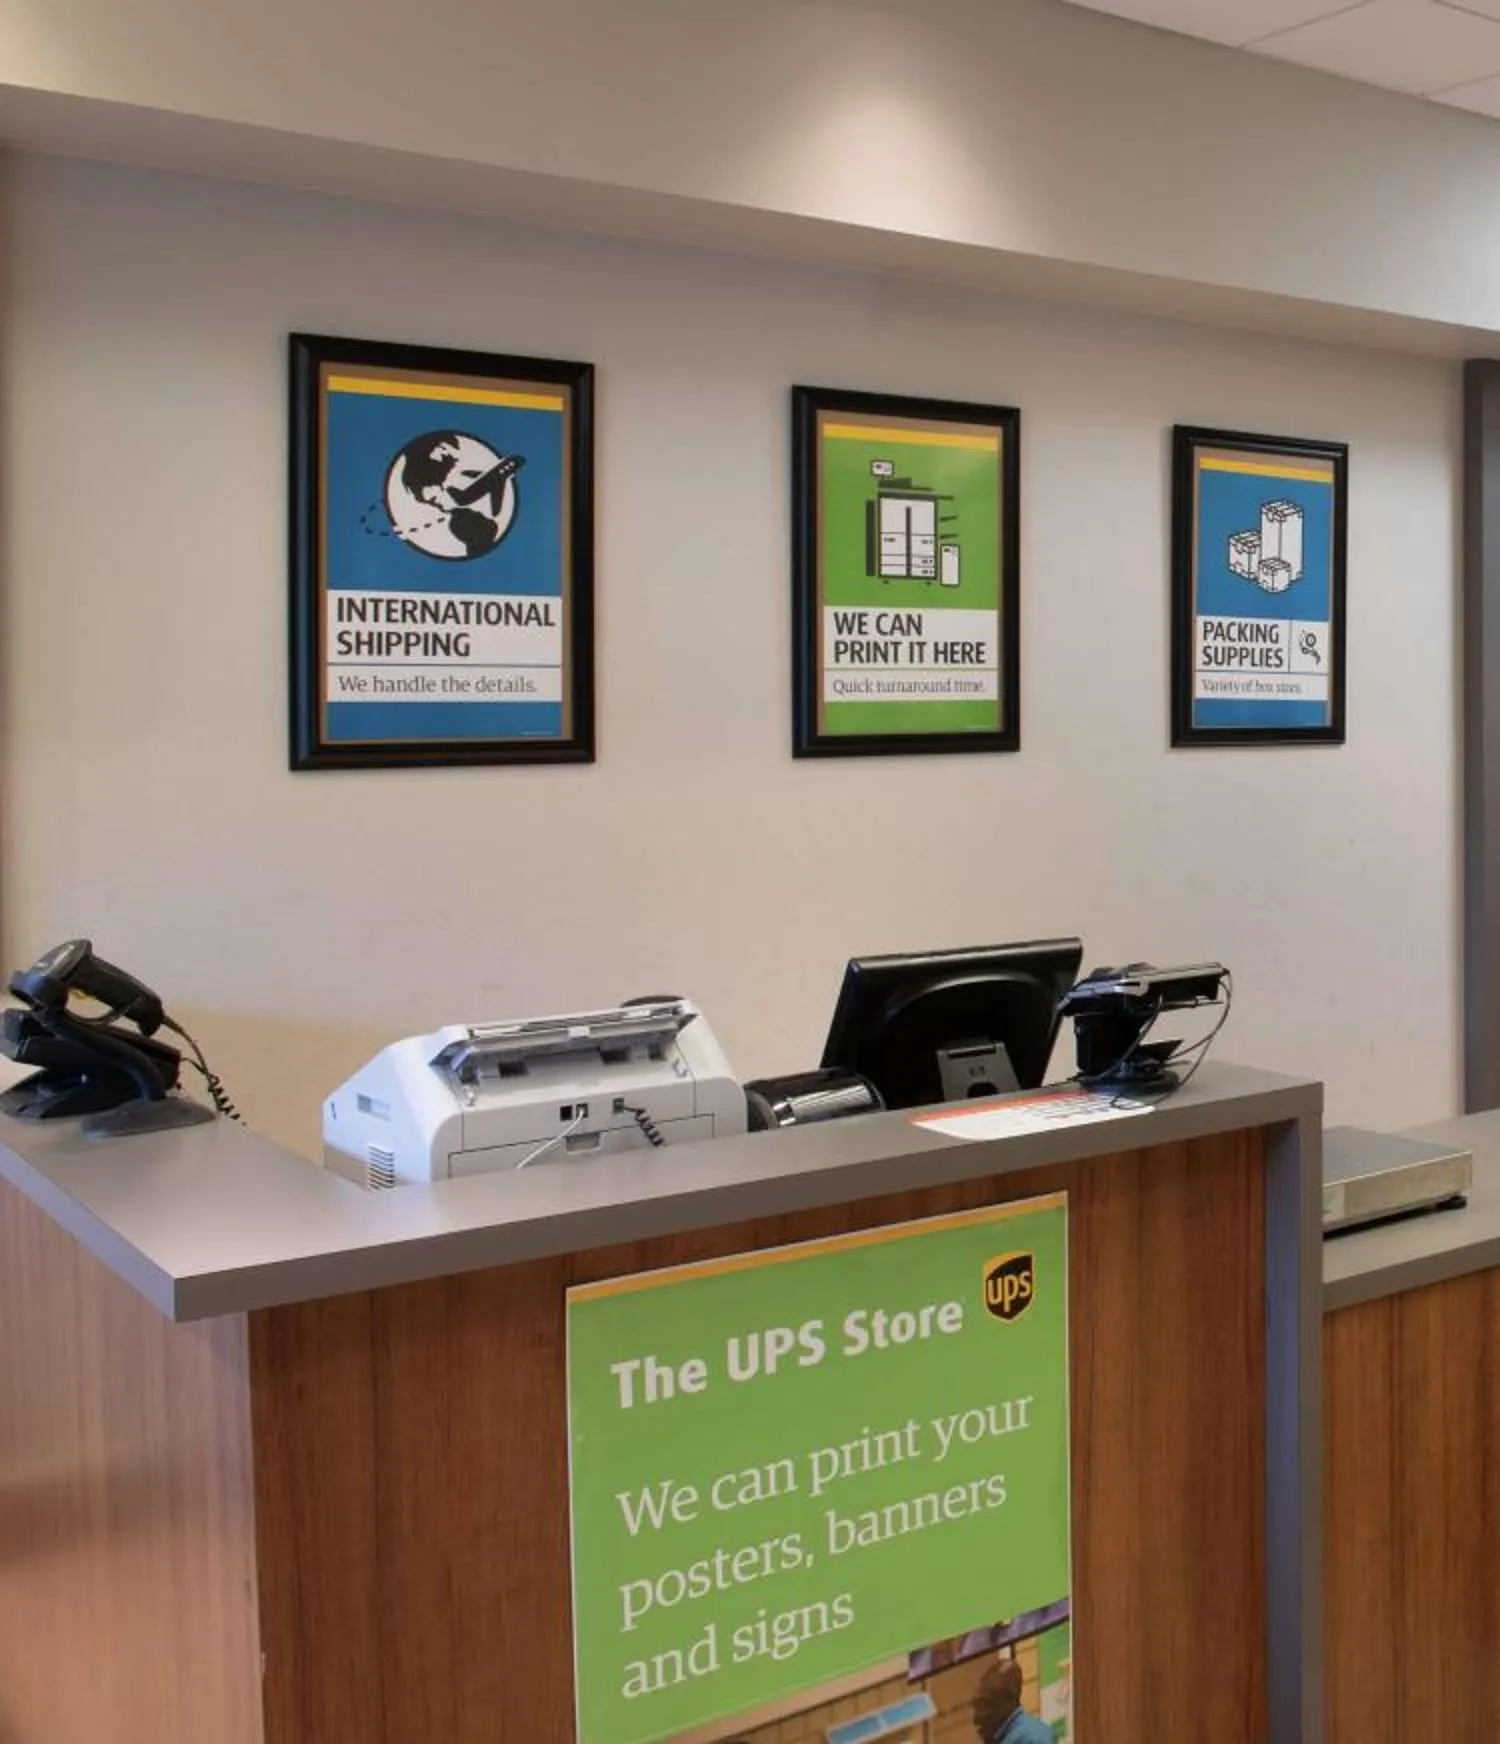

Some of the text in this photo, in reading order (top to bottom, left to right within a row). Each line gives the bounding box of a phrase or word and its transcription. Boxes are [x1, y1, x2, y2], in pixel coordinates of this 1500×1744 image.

[336, 597, 555, 627] INTERNATIONAL
[834, 612, 922, 637] WE CAN
[337, 630, 470, 657] SHIPPING
[1202, 621, 1279, 643] PACKING
[834, 641, 986, 664] PRINT IT HERE
[1202, 646, 1283, 668] SUPPLIES
[338, 675, 537, 693] We handle the details.
[833, 678, 985, 694] Quick turnaround time.
[1202, 679, 1240, 693] Variety
[1242, 680, 1253, 692] of
[986, 1270, 1031, 1312] ups
[611, 1301, 964, 1409] The UPS Store
[615, 1396, 1034, 1538] We can print your
[618, 1474, 1007, 1632] posters, banners
[621, 1592, 855, 1700] and signs
